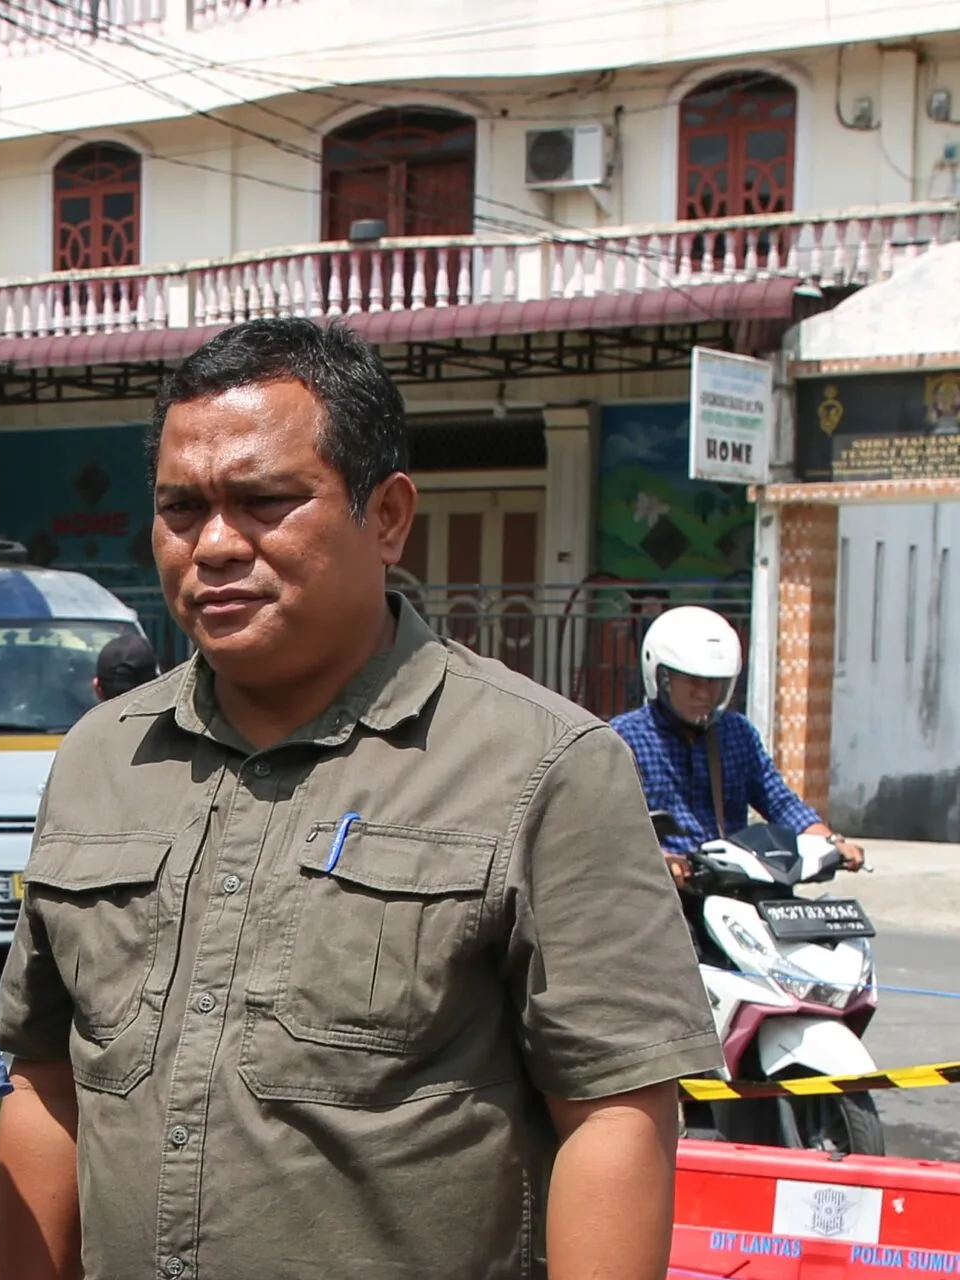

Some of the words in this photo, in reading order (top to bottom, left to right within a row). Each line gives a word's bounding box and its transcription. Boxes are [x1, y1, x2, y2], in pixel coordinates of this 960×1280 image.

[706, 437, 753, 465] HOME
[709, 1230, 737, 1251] DIT
[740, 1233, 803, 1258] LANTAS
[849, 1244, 904, 1268] POLDA
